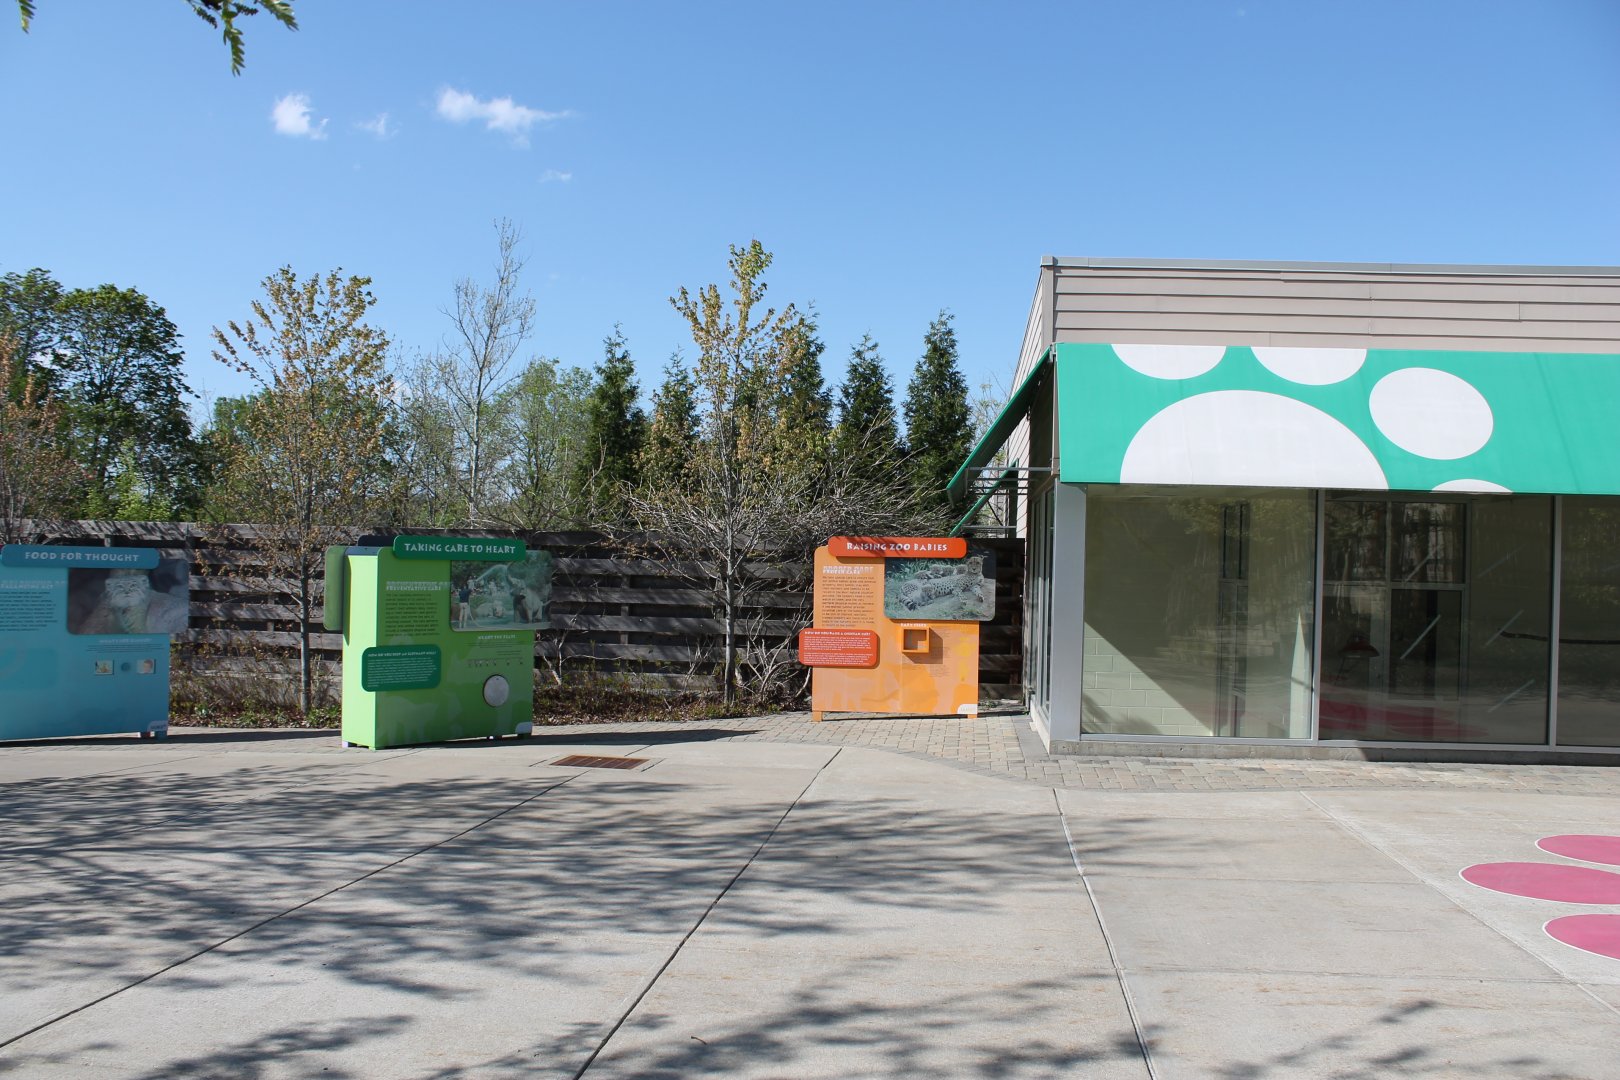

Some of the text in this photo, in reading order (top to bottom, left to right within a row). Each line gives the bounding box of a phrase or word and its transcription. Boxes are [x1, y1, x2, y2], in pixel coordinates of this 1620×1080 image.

[404, 543, 516, 554] TAKING CARE TO HEART
[846, 542, 948, 551] RAISING ZOO BABIES
[25, 551, 140, 562] FOOD FOR THOUGHT
